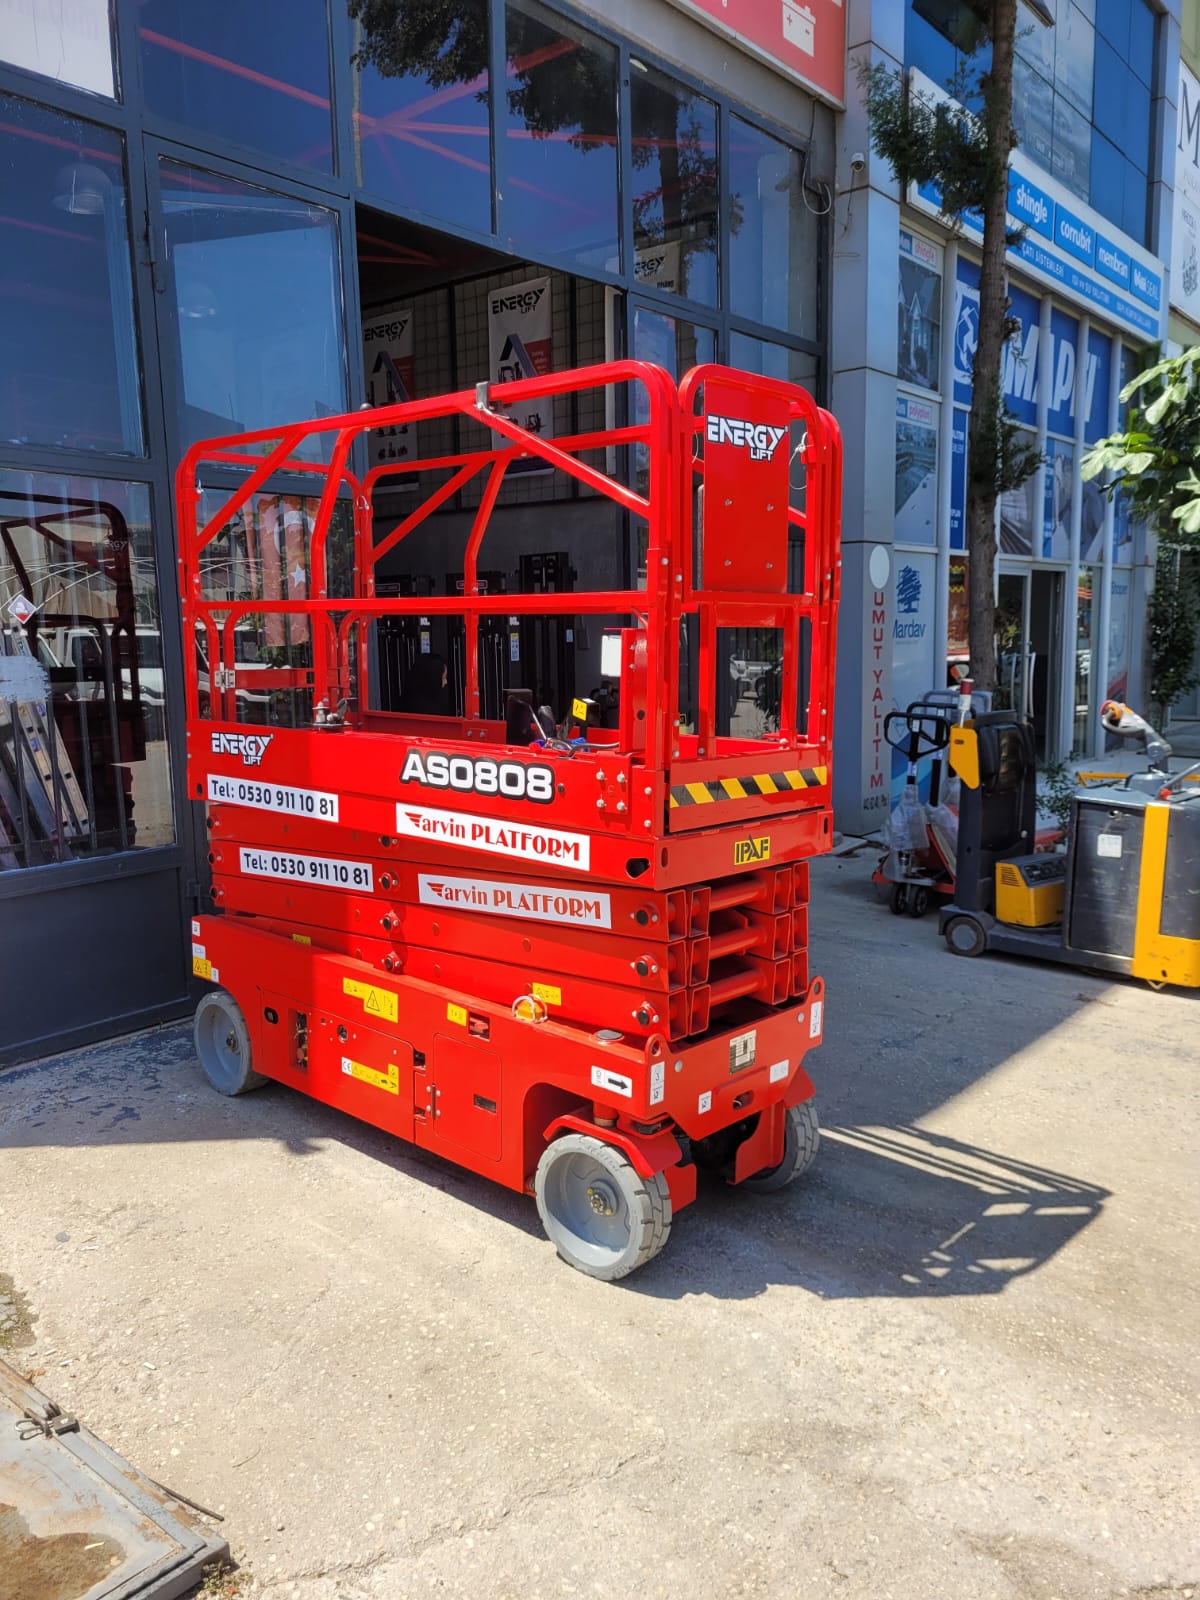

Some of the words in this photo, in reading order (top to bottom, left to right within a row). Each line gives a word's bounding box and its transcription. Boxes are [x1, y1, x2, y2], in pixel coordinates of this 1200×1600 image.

[1016, 184, 1047, 223] shingle
[1060, 220, 1091, 253] corrubit
[1099, 248, 1128, 278] membran
[492, 288, 545, 315] ENERGY
[520, 304, 537, 314] LIFT
[364, 319, 409, 342] ENERGY
[707, 415, 785, 451] ENERGY
[750, 447, 773, 461] LIFT
[871, 591, 885, 660] UMUT
[211, 732, 272, 757] ENERGY
[243, 755, 262, 766] LIFT
[401, 753, 553, 800] AS0808
[211, 780, 234, 798] Tel:
[238, 784, 272, 805] 0530
[276, 791, 295, 809] 911
[299, 794, 314, 813] 10
[319, 798, 334, 817] 81
[471, 823, 580, 862] PLATFORM
[736, 834, 769, 863] IPAF
[243, 853, 268, 871] Tel:
[271, 856, 305, 876] 0530
[310, 862, 329, 880] 911
[333, 864, 348, 883] 10
[353, 867, 369, 886] 81
[493, 889, 601, 920] PLATFORM
